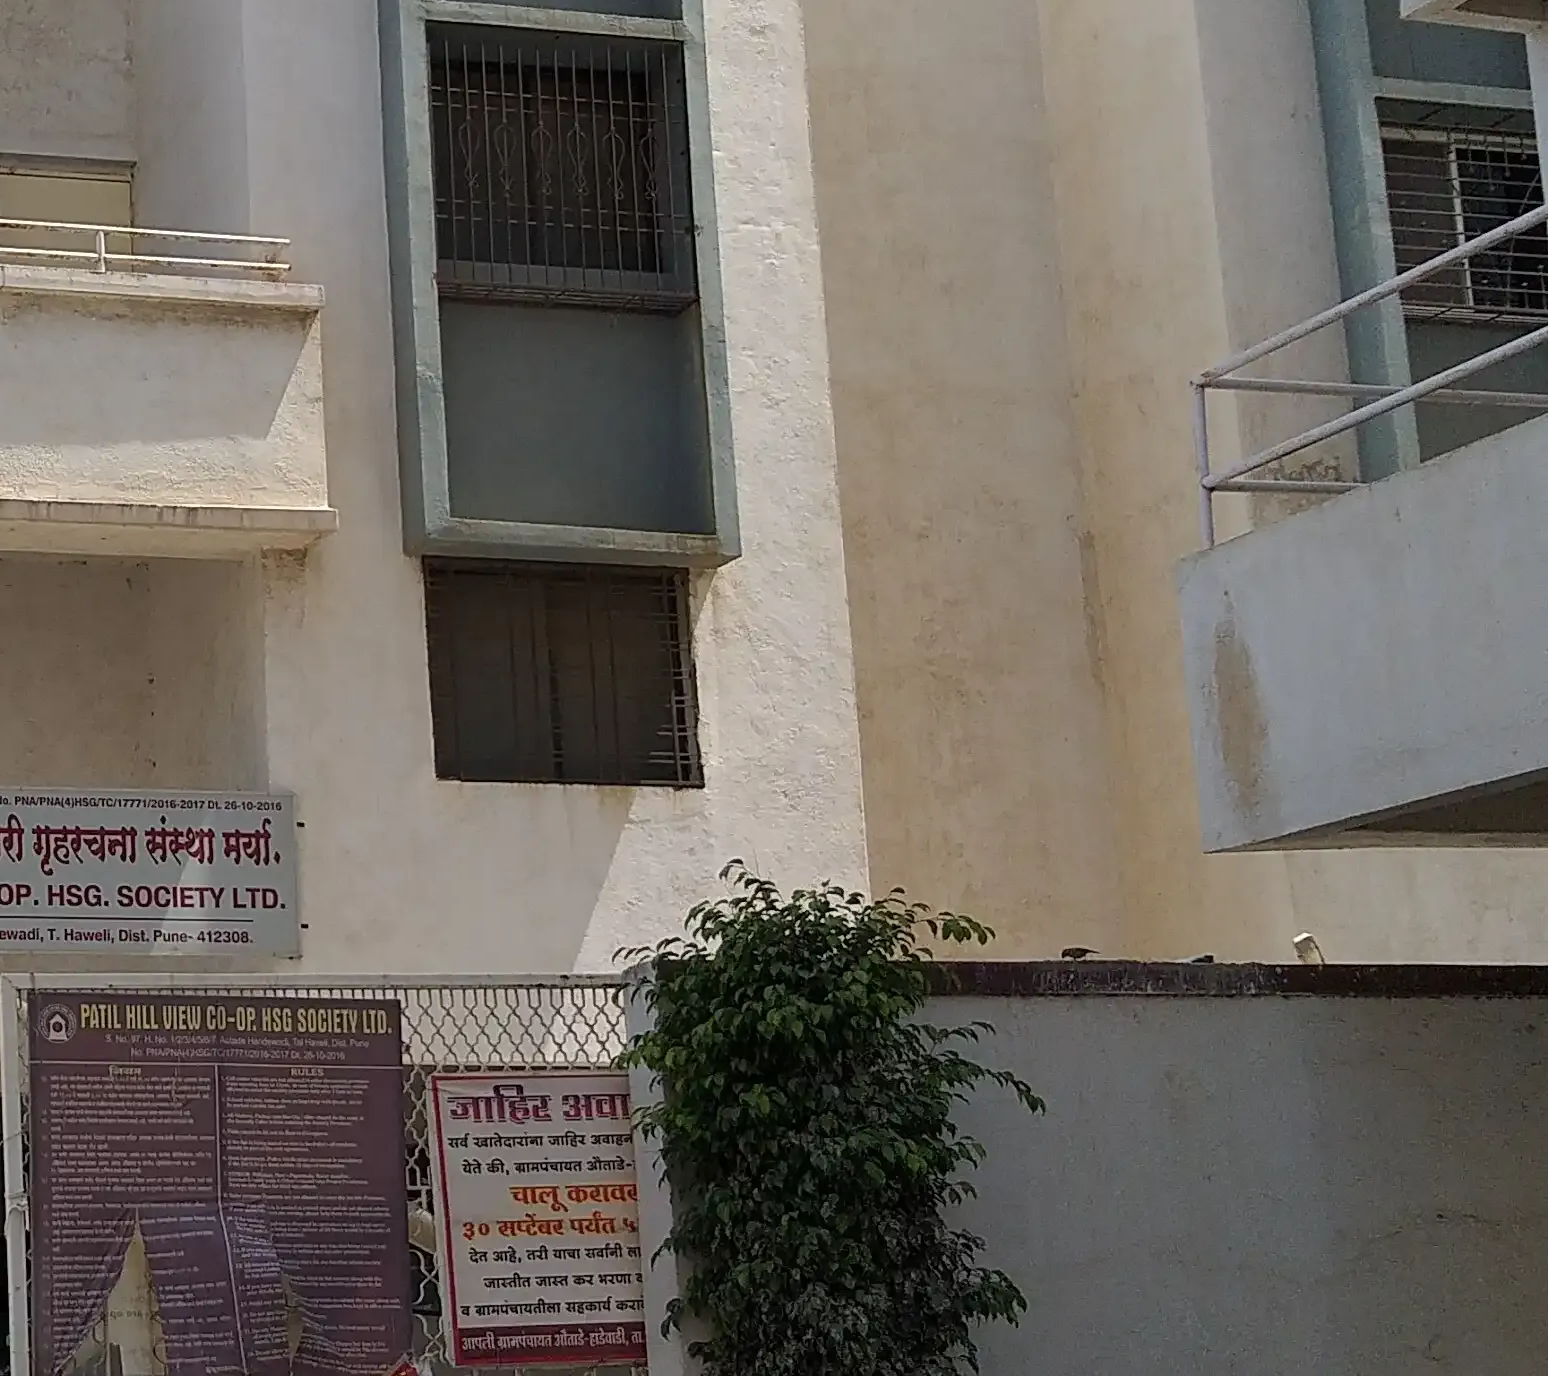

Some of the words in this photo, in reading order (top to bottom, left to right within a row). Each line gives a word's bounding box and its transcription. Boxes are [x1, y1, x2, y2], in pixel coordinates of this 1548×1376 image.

[224, 801, 282, 811] 26-10-2016
[32, 824, 137, 876] गृहरचना
[144, 815, 215, 866] संस्था
[222, 817, 281, 866] मर्या.
[47, 884, 110, 908] HSG.
[116, 885, 225, 909] SOCIETY
[232, 887, 287, 910] LTD.
[47, 929, 60, 941] T.
[64, 928, 115, 944] Haweli,
[119, 929, 150, 943] Dist.
[153, 929, 194, 943] Pune-
[197, 930, 253, 944] 412308.
[80, 1003, 122, 1029] PATIL
[126, 1004, 159, 1030] HILL
[163, 1005, 201, 1031] VIEW
[206, 1005, 256, 1032] CO-OP.
[262, 1007, 293, 1033] HSG
[297, 1007, 359, 1034] SOCIETY
[363, 1009, 393, 1034] LTD.
[290, 1068, 325, 1077] RULES
[447, 1084, 553, 1124] जाहिर
[561, 1094, 631, 1121] अवा
[447, 1133, 470, 1149] सर्व
[473, 1131, 543, 1149] खातेदारांना
[548, 1131, 586, 1147] जाहिर
[461, 1157, 482, 1175] येते
[486, 1156, 510, 1176] की,
[514, 1156, 582, 1175] ग्रामपंचायत
[586, 1155, 635, 1172] औताडे-
[508, 1185, 569, 1213] चालू
[462, 1221, 490, 1241] ३०
[496, 1212, 564, 1237] सप्टेंबर
[569, 1210, 617, 1235] पर्यंत
[469, 1247, 488, 1264] देत
[492, 1246, 522, 1264] आहे,
[526, 1245, 548, 1261] तरी
[552, 1247, 581, 1260] याचा
[626, 1245, 642, 1259] ला
[483, 1272, 531, 1289] जास्तीत
[535, 1274, 569, 1287] जास्त
[573, 1274, 595, 1286] कर
[598, 1272, 632, 1285] भरणा
[460, 1304, 470, 1317] व
[474, 1298, 561, 1317] ग्रामपंचायतीला
[565, 1295, 614, 1315] सहकार्य
[462, 1330, 495, 1352] आपली
[496, 1330, 553, 1352] ग्रामपंचायत
